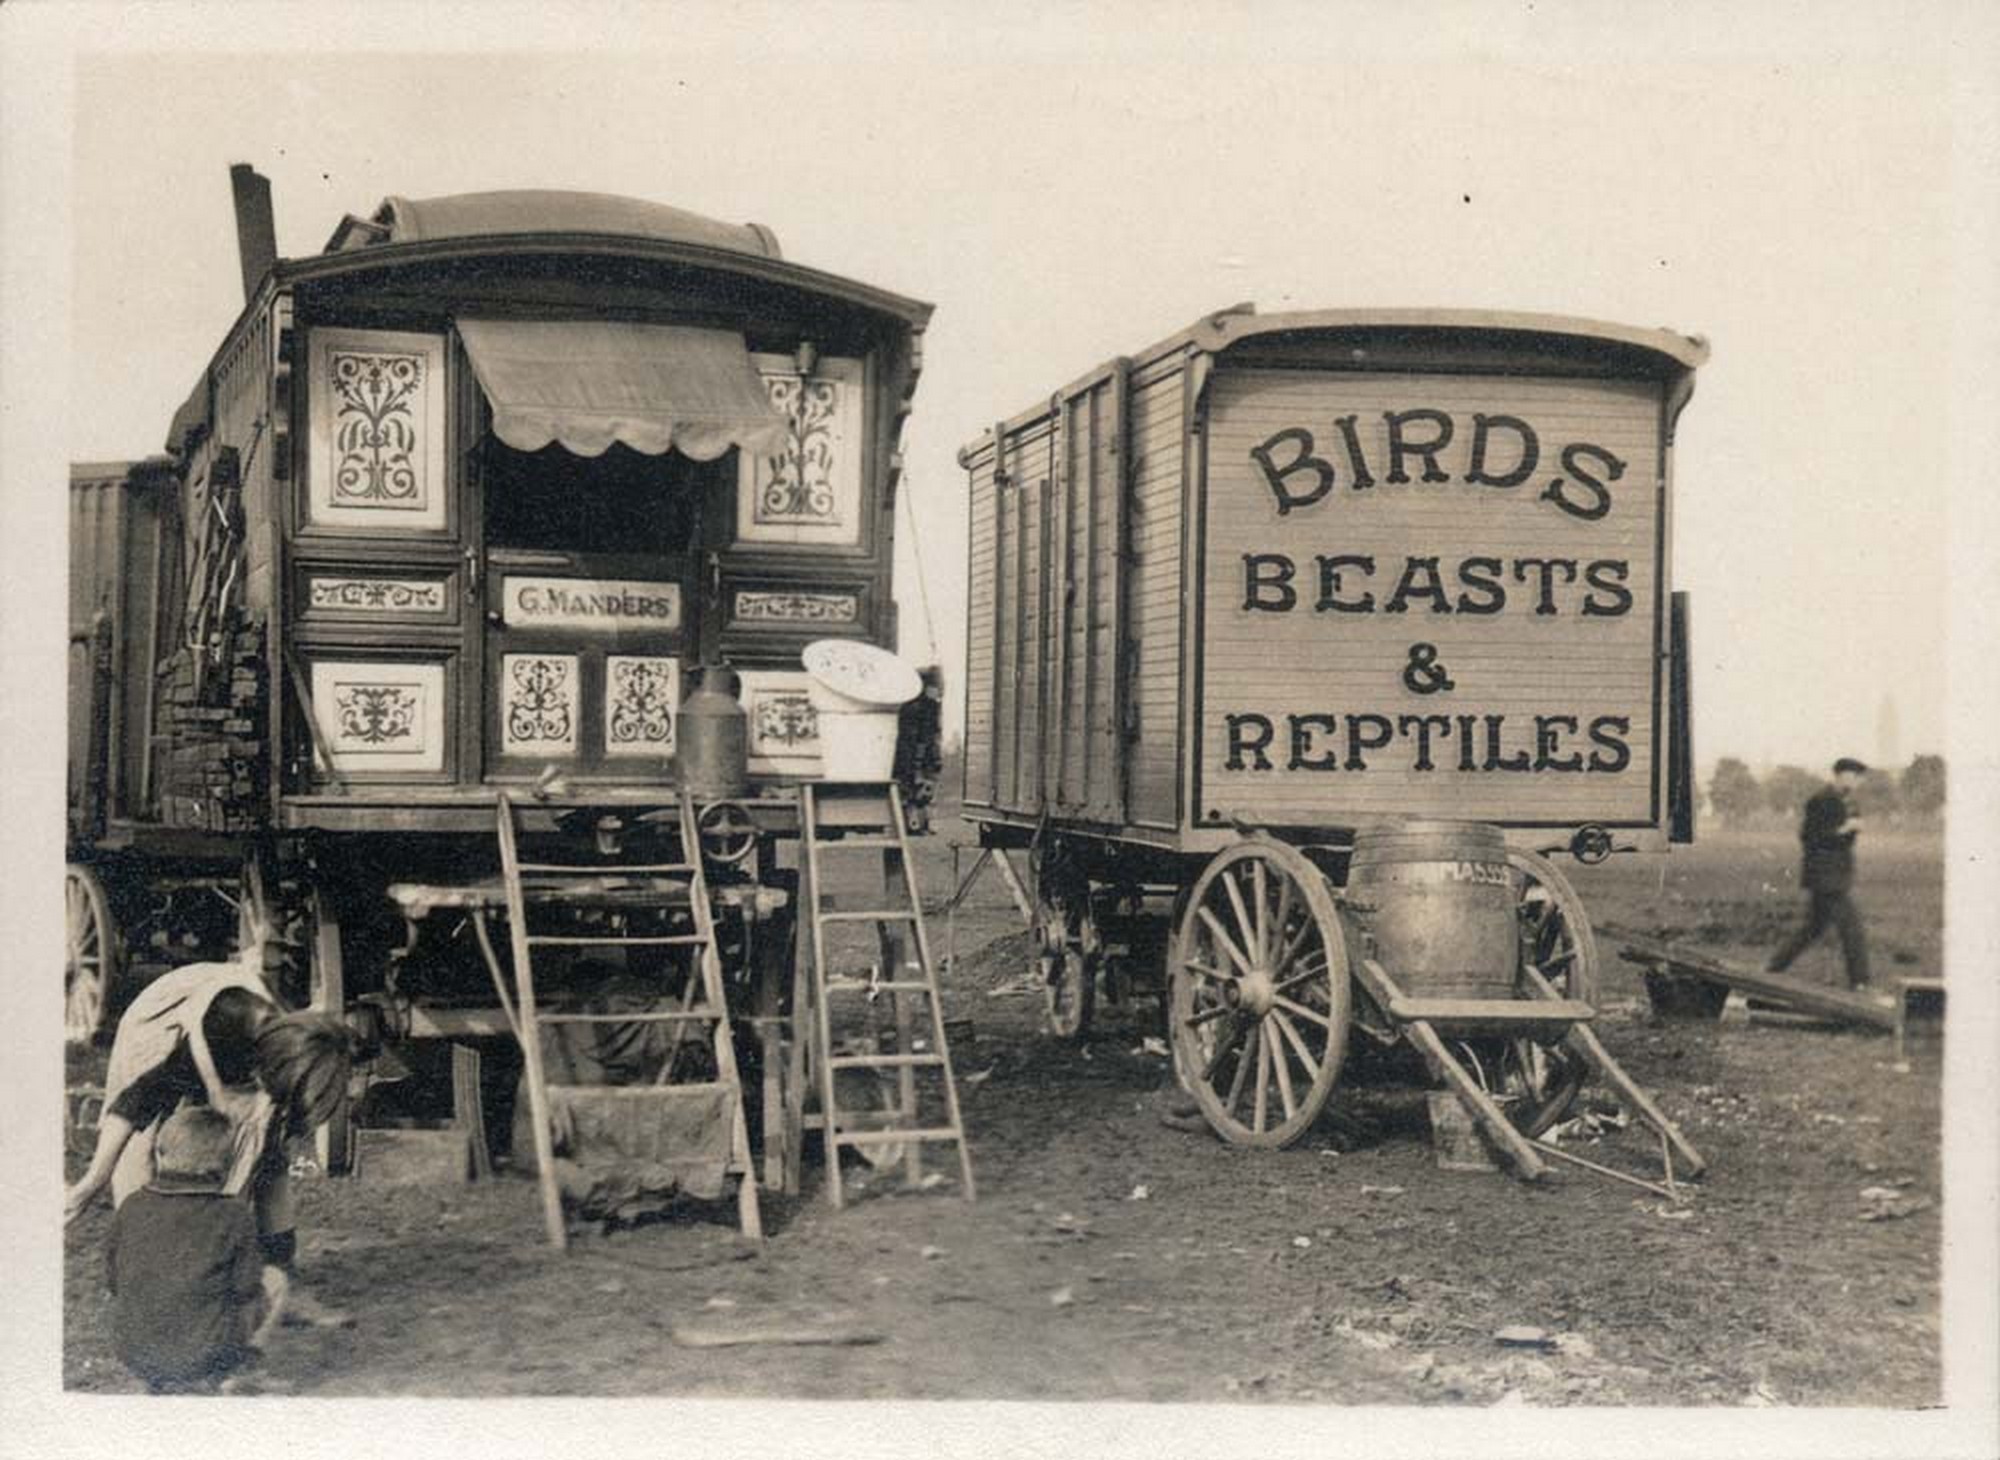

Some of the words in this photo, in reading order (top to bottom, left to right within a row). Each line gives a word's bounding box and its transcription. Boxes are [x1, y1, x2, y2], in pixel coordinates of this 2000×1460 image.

[1250, 409, 1627, 521] BIRDS
[1241, 554, 1633, 616] BEASTS
[1402, 642, 1455, 695] &
[1224, 713, 1632, 773] REPTILES
